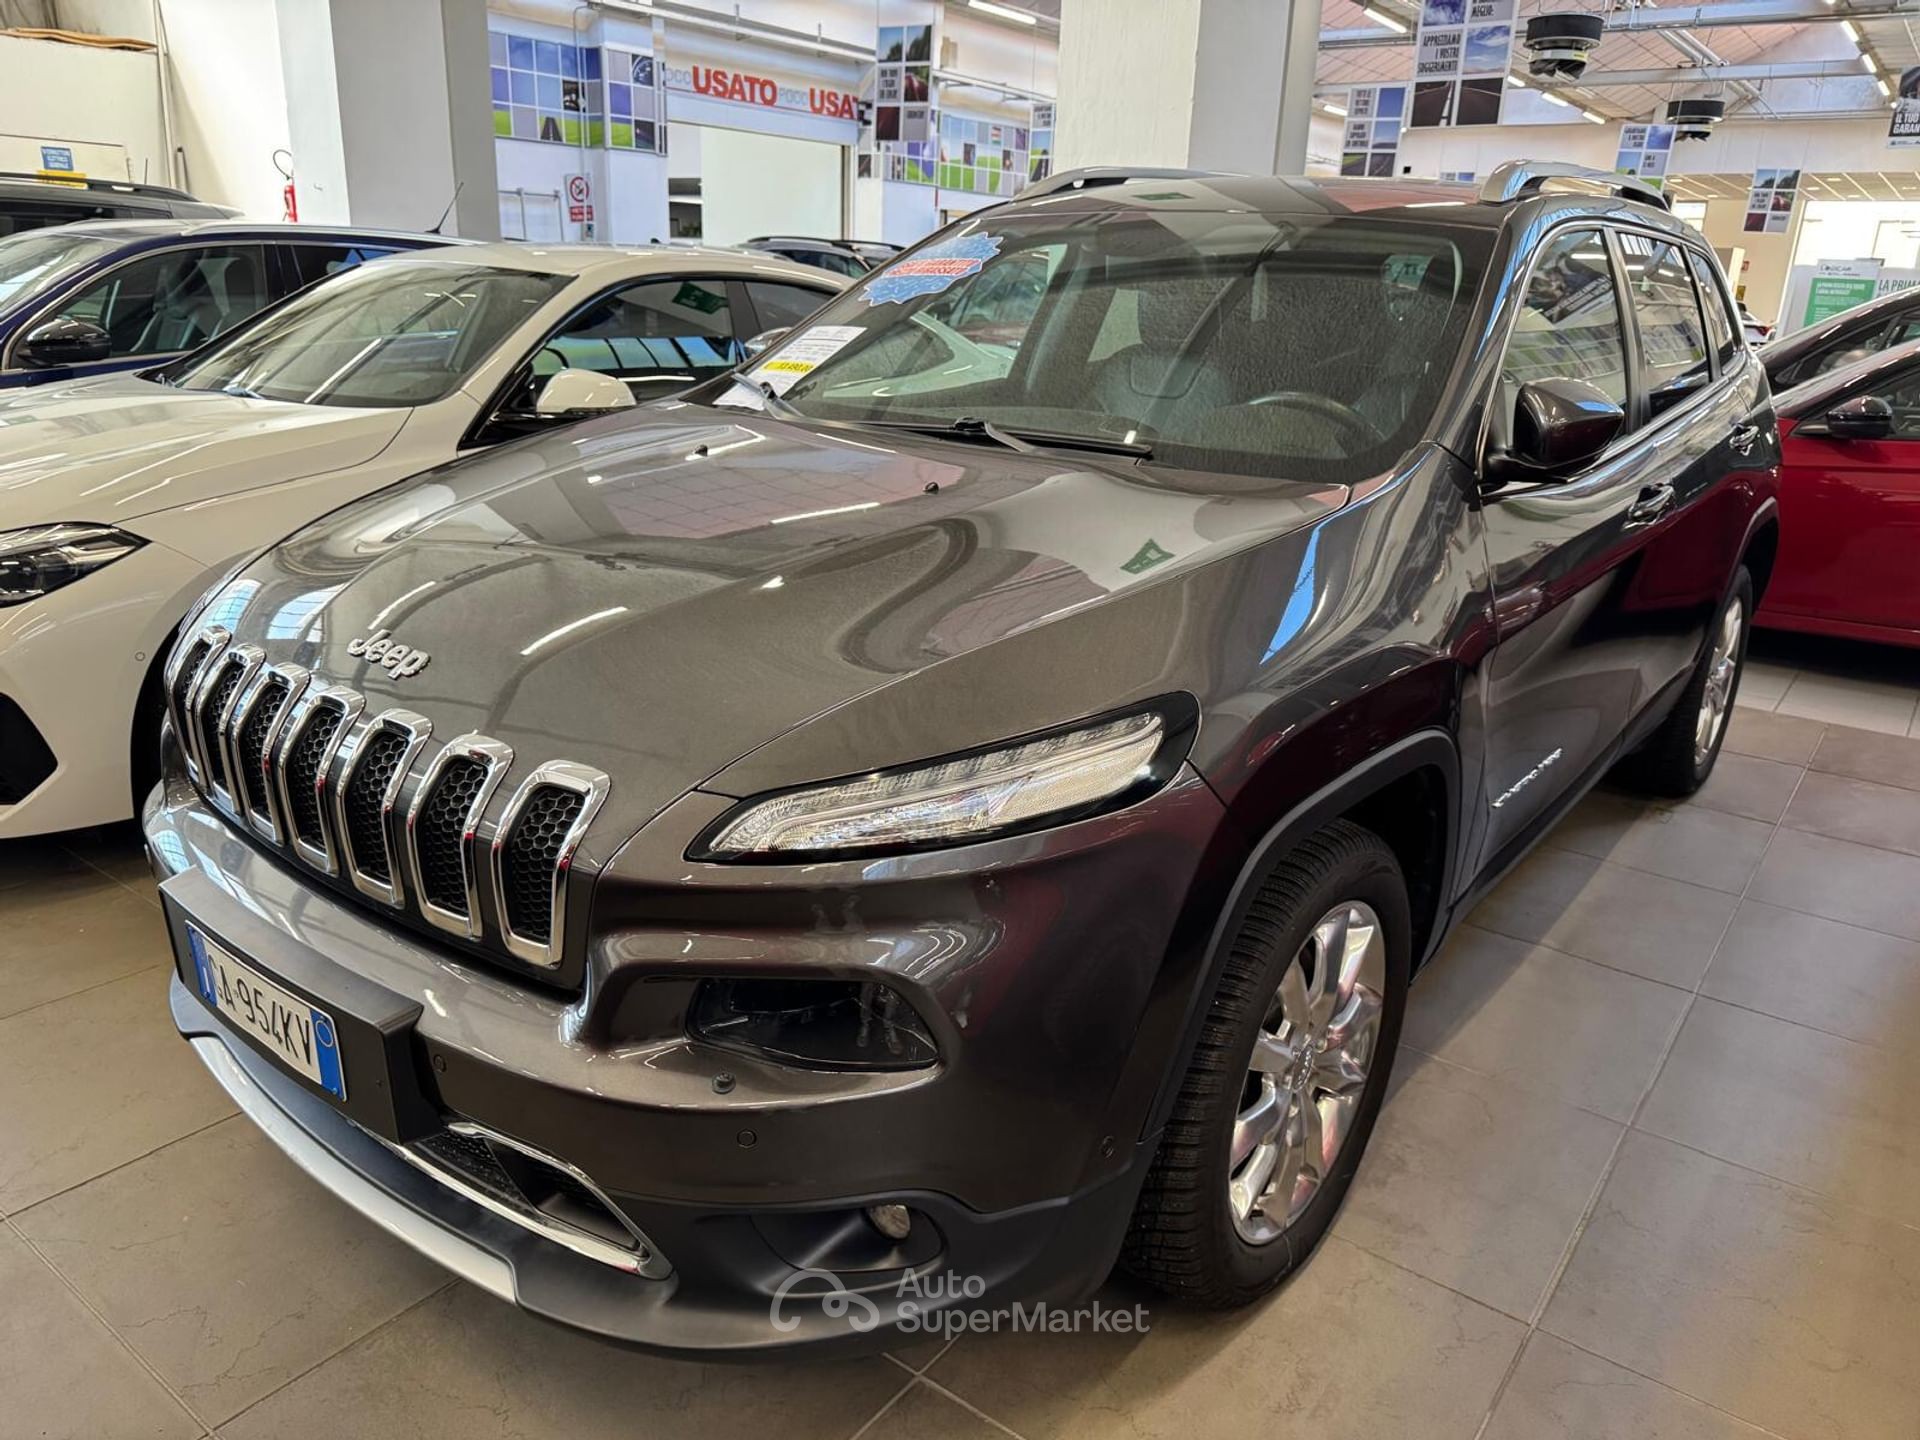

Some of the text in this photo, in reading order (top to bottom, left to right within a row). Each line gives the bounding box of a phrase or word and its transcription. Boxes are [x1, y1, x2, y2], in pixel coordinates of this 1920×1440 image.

[692, 64, 777, 107] USATO
[1903, 112, 1920, 124] TUO
[347, 629, 431, 680] Jeep
